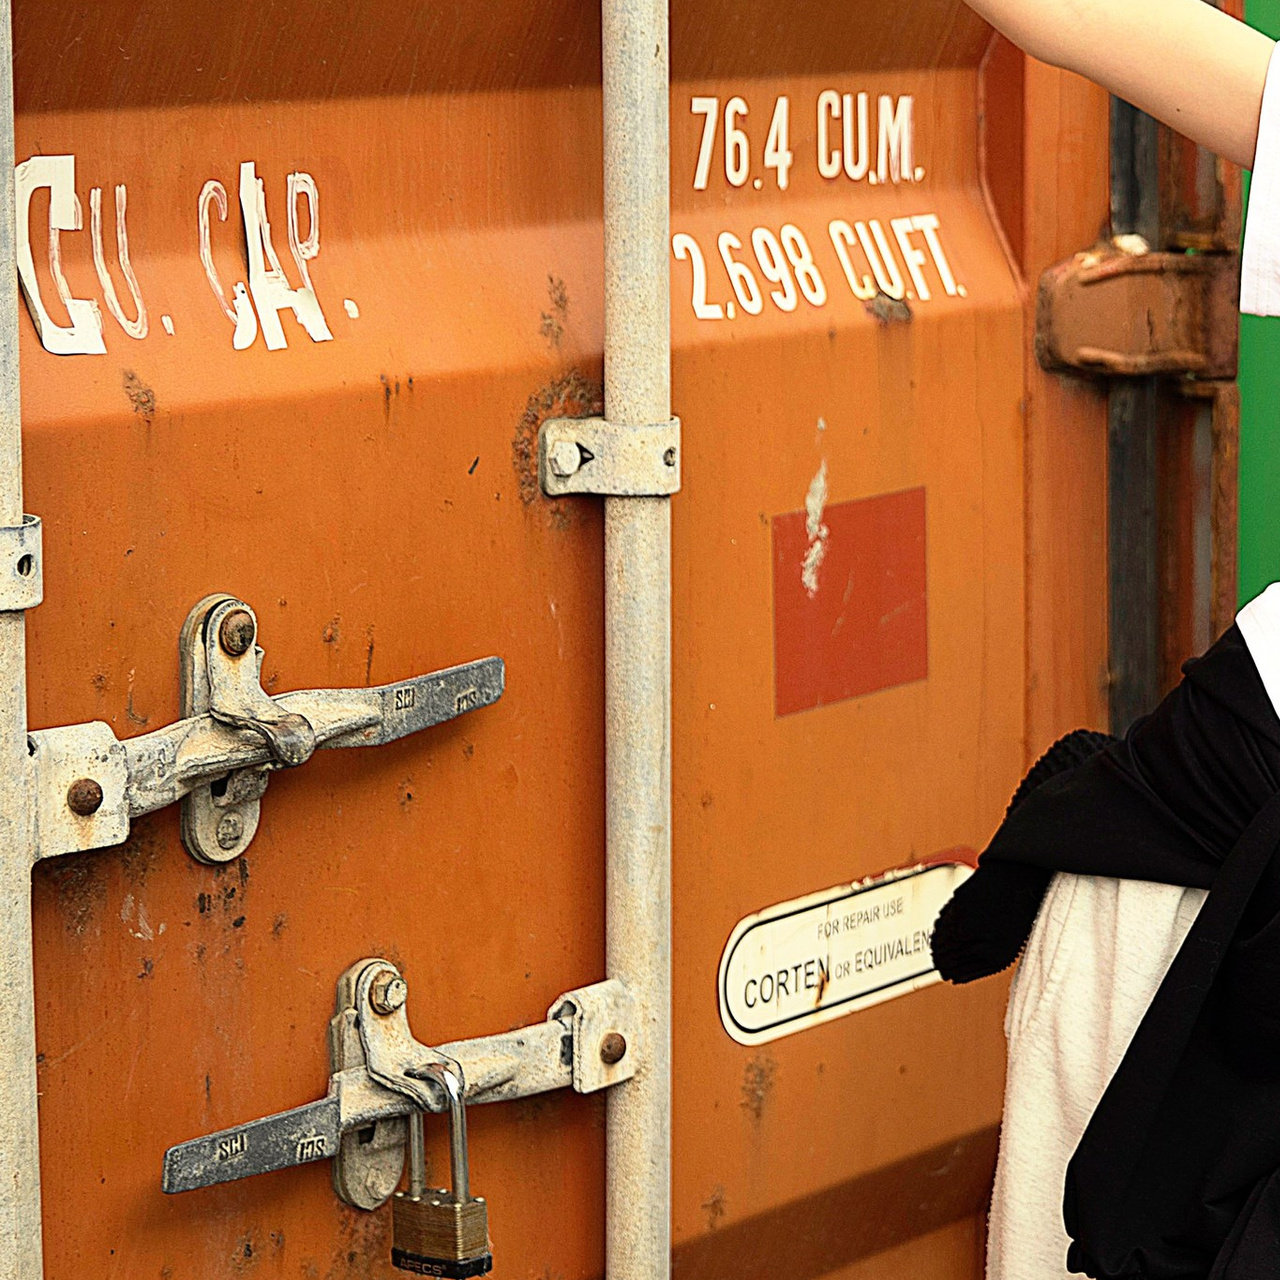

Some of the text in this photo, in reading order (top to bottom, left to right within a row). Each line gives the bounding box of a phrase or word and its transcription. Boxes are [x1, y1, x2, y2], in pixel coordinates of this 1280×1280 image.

[690, 96, 793, 191] 76.4
[672, 231, 827, 321] 2,698
[817, 897, 904, 939] FOR REPAIR USE
[834, 960, 851, 980] OR
[854, 927, 936, 973] EQUIVALEN
